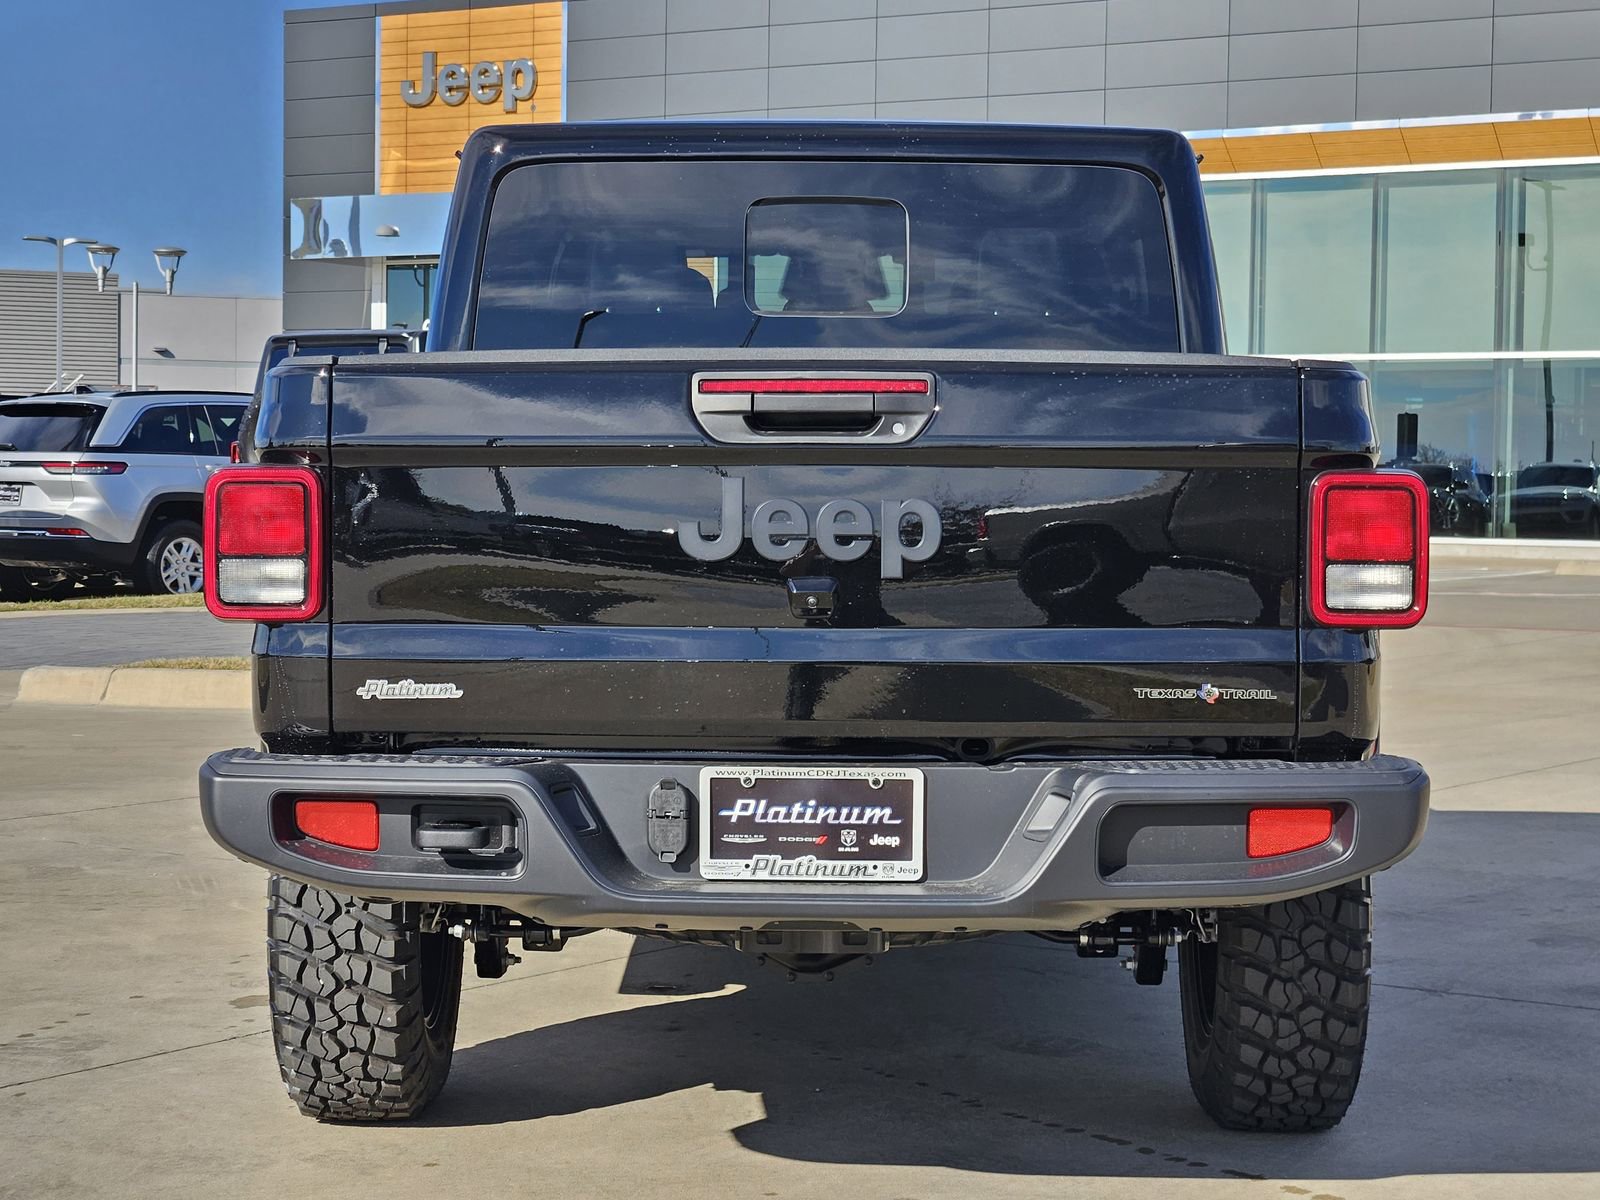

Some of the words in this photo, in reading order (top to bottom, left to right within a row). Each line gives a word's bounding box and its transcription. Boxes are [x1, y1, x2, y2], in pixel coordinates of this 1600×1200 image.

[400, 52, 538, 113] Jeep
[678, 476, 942, 579] Jeep
[356, 679, 464, 700] Platinum
[1133, 688, 1197, 699] TEXAS
[1219, 688, 1278, 700] TRAIL
[715, 769, 907, 778] www.PlatinumCDRJTexas.com
[718, 799, 902, 825] Platinum
[869, 833, 901, 848] Jeep
[748, 858, 878, 878] Platinum
[897, 867, 919, 875] Jeep
